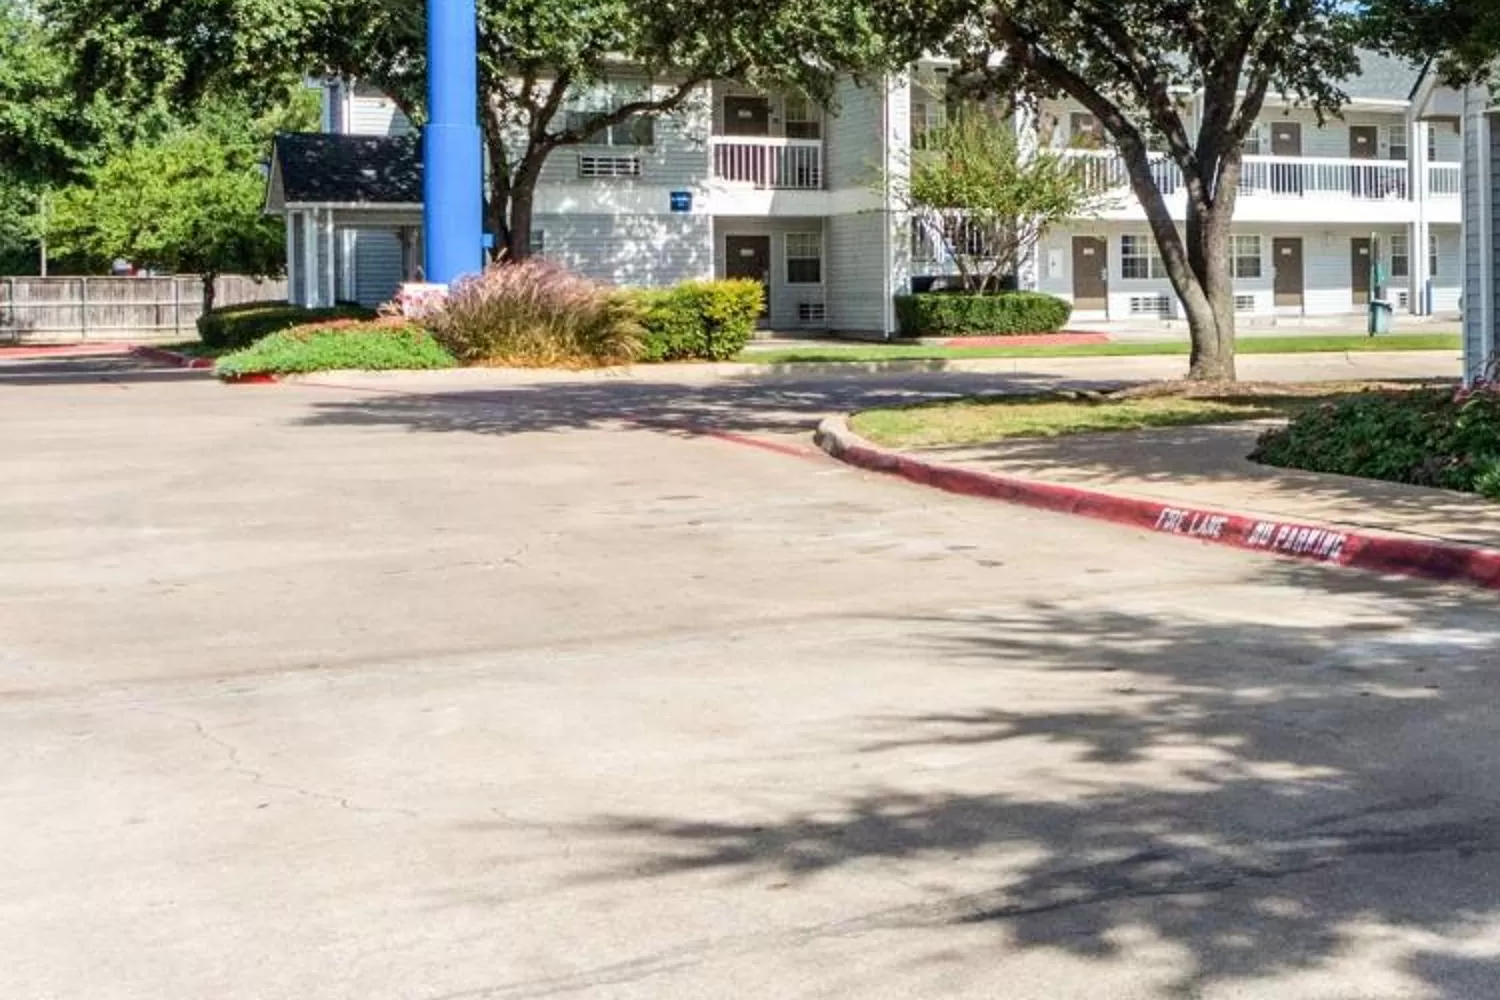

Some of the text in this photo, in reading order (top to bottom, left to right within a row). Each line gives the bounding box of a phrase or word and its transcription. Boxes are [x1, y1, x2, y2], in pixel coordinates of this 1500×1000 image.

[1154, 507, 1348, 559] FIRE LANE NO PARKING
